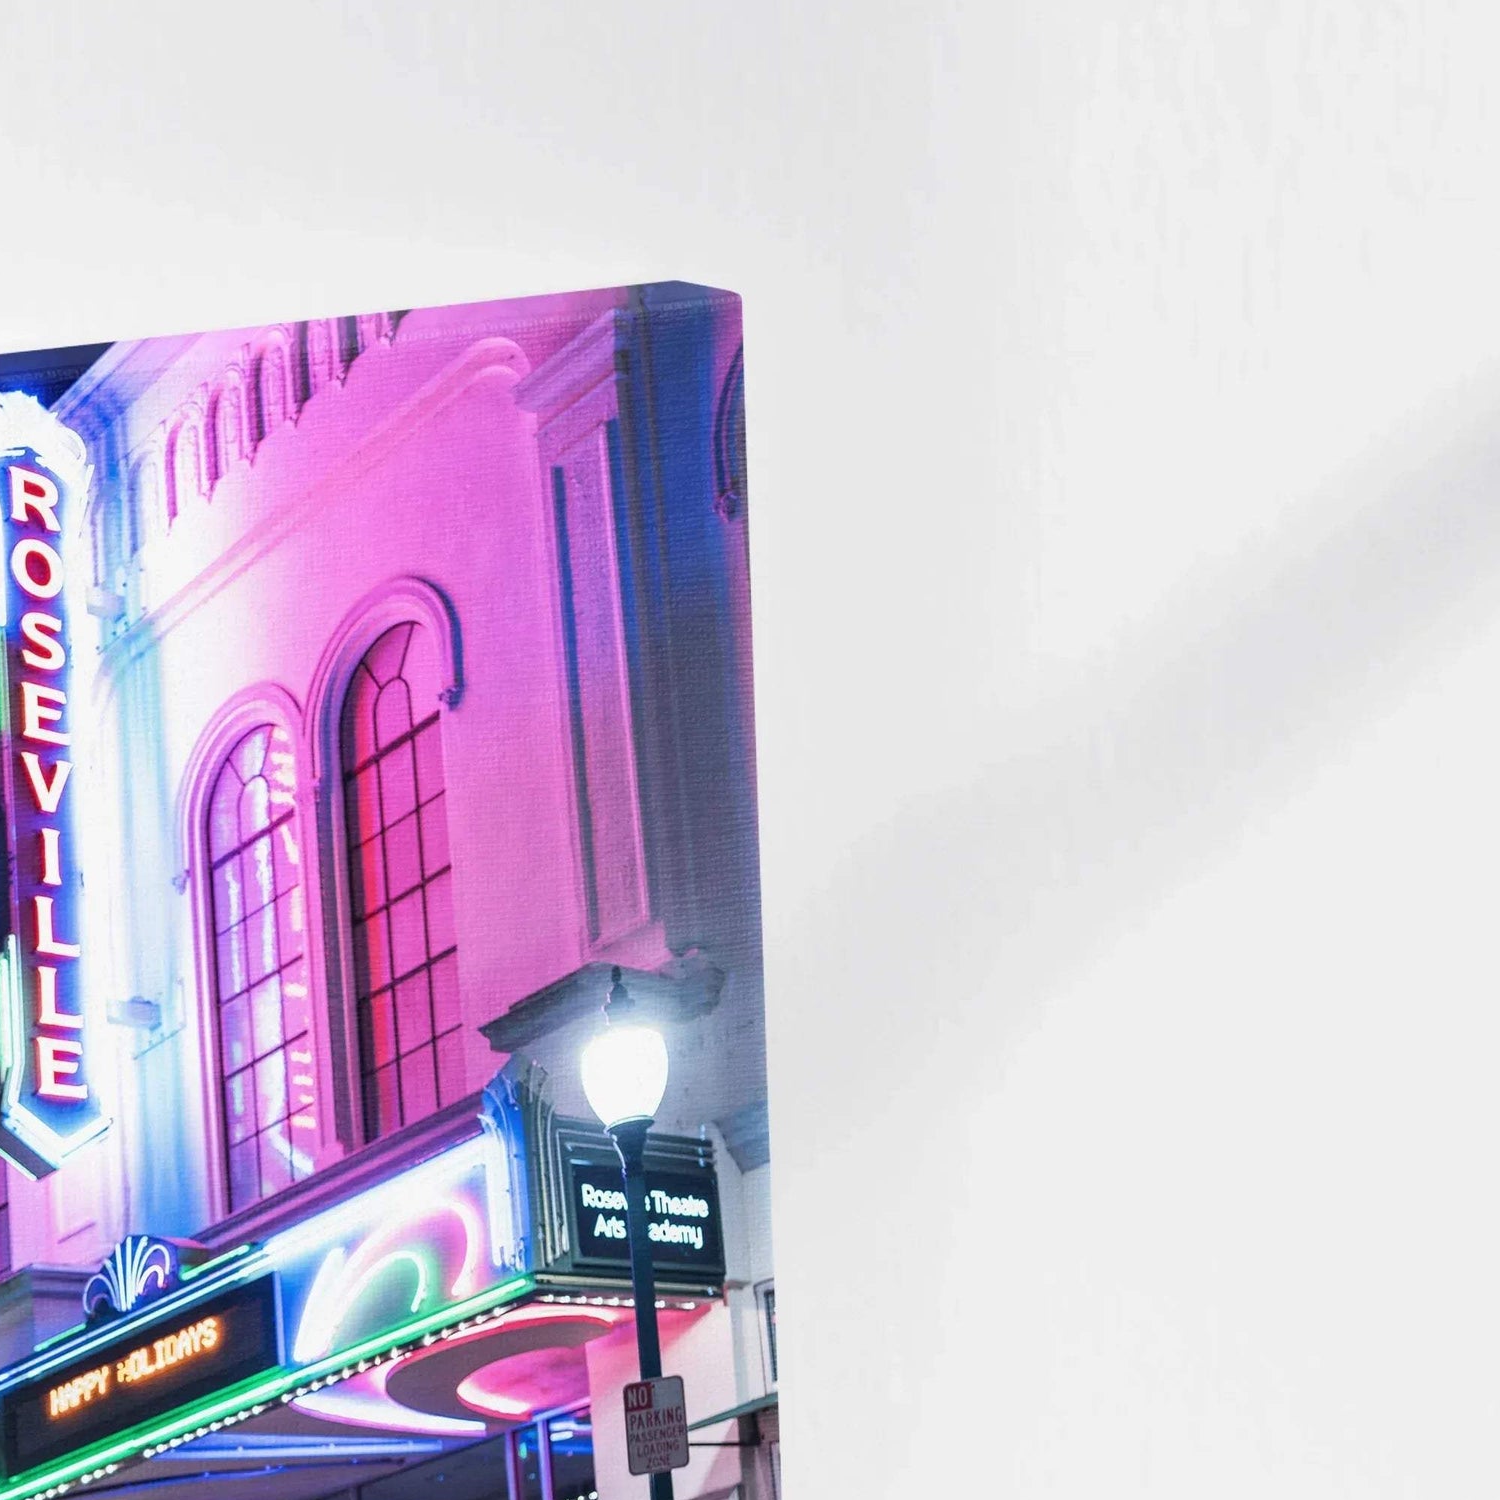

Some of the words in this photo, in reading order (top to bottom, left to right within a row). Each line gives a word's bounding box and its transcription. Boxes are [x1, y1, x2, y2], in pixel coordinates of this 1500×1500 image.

[8, 465, 88, 1100] ROSEVILLE
[650, 1190, 709, 1218] Theatre
[594, 1213, 627, 1239] Arts
[648, 1219, 703, 1250] ademy
[49, 1365, 109, 1417] HAPPY
[627, 1386, 648, 1409] NO
[630, 1406, 683, 1430] PARKING
[630, 1424, 686, 1444] PASSENGER
[636, 1439, 680, 1458] LOADING
[646, 1454, 671, 1469] ZONE
